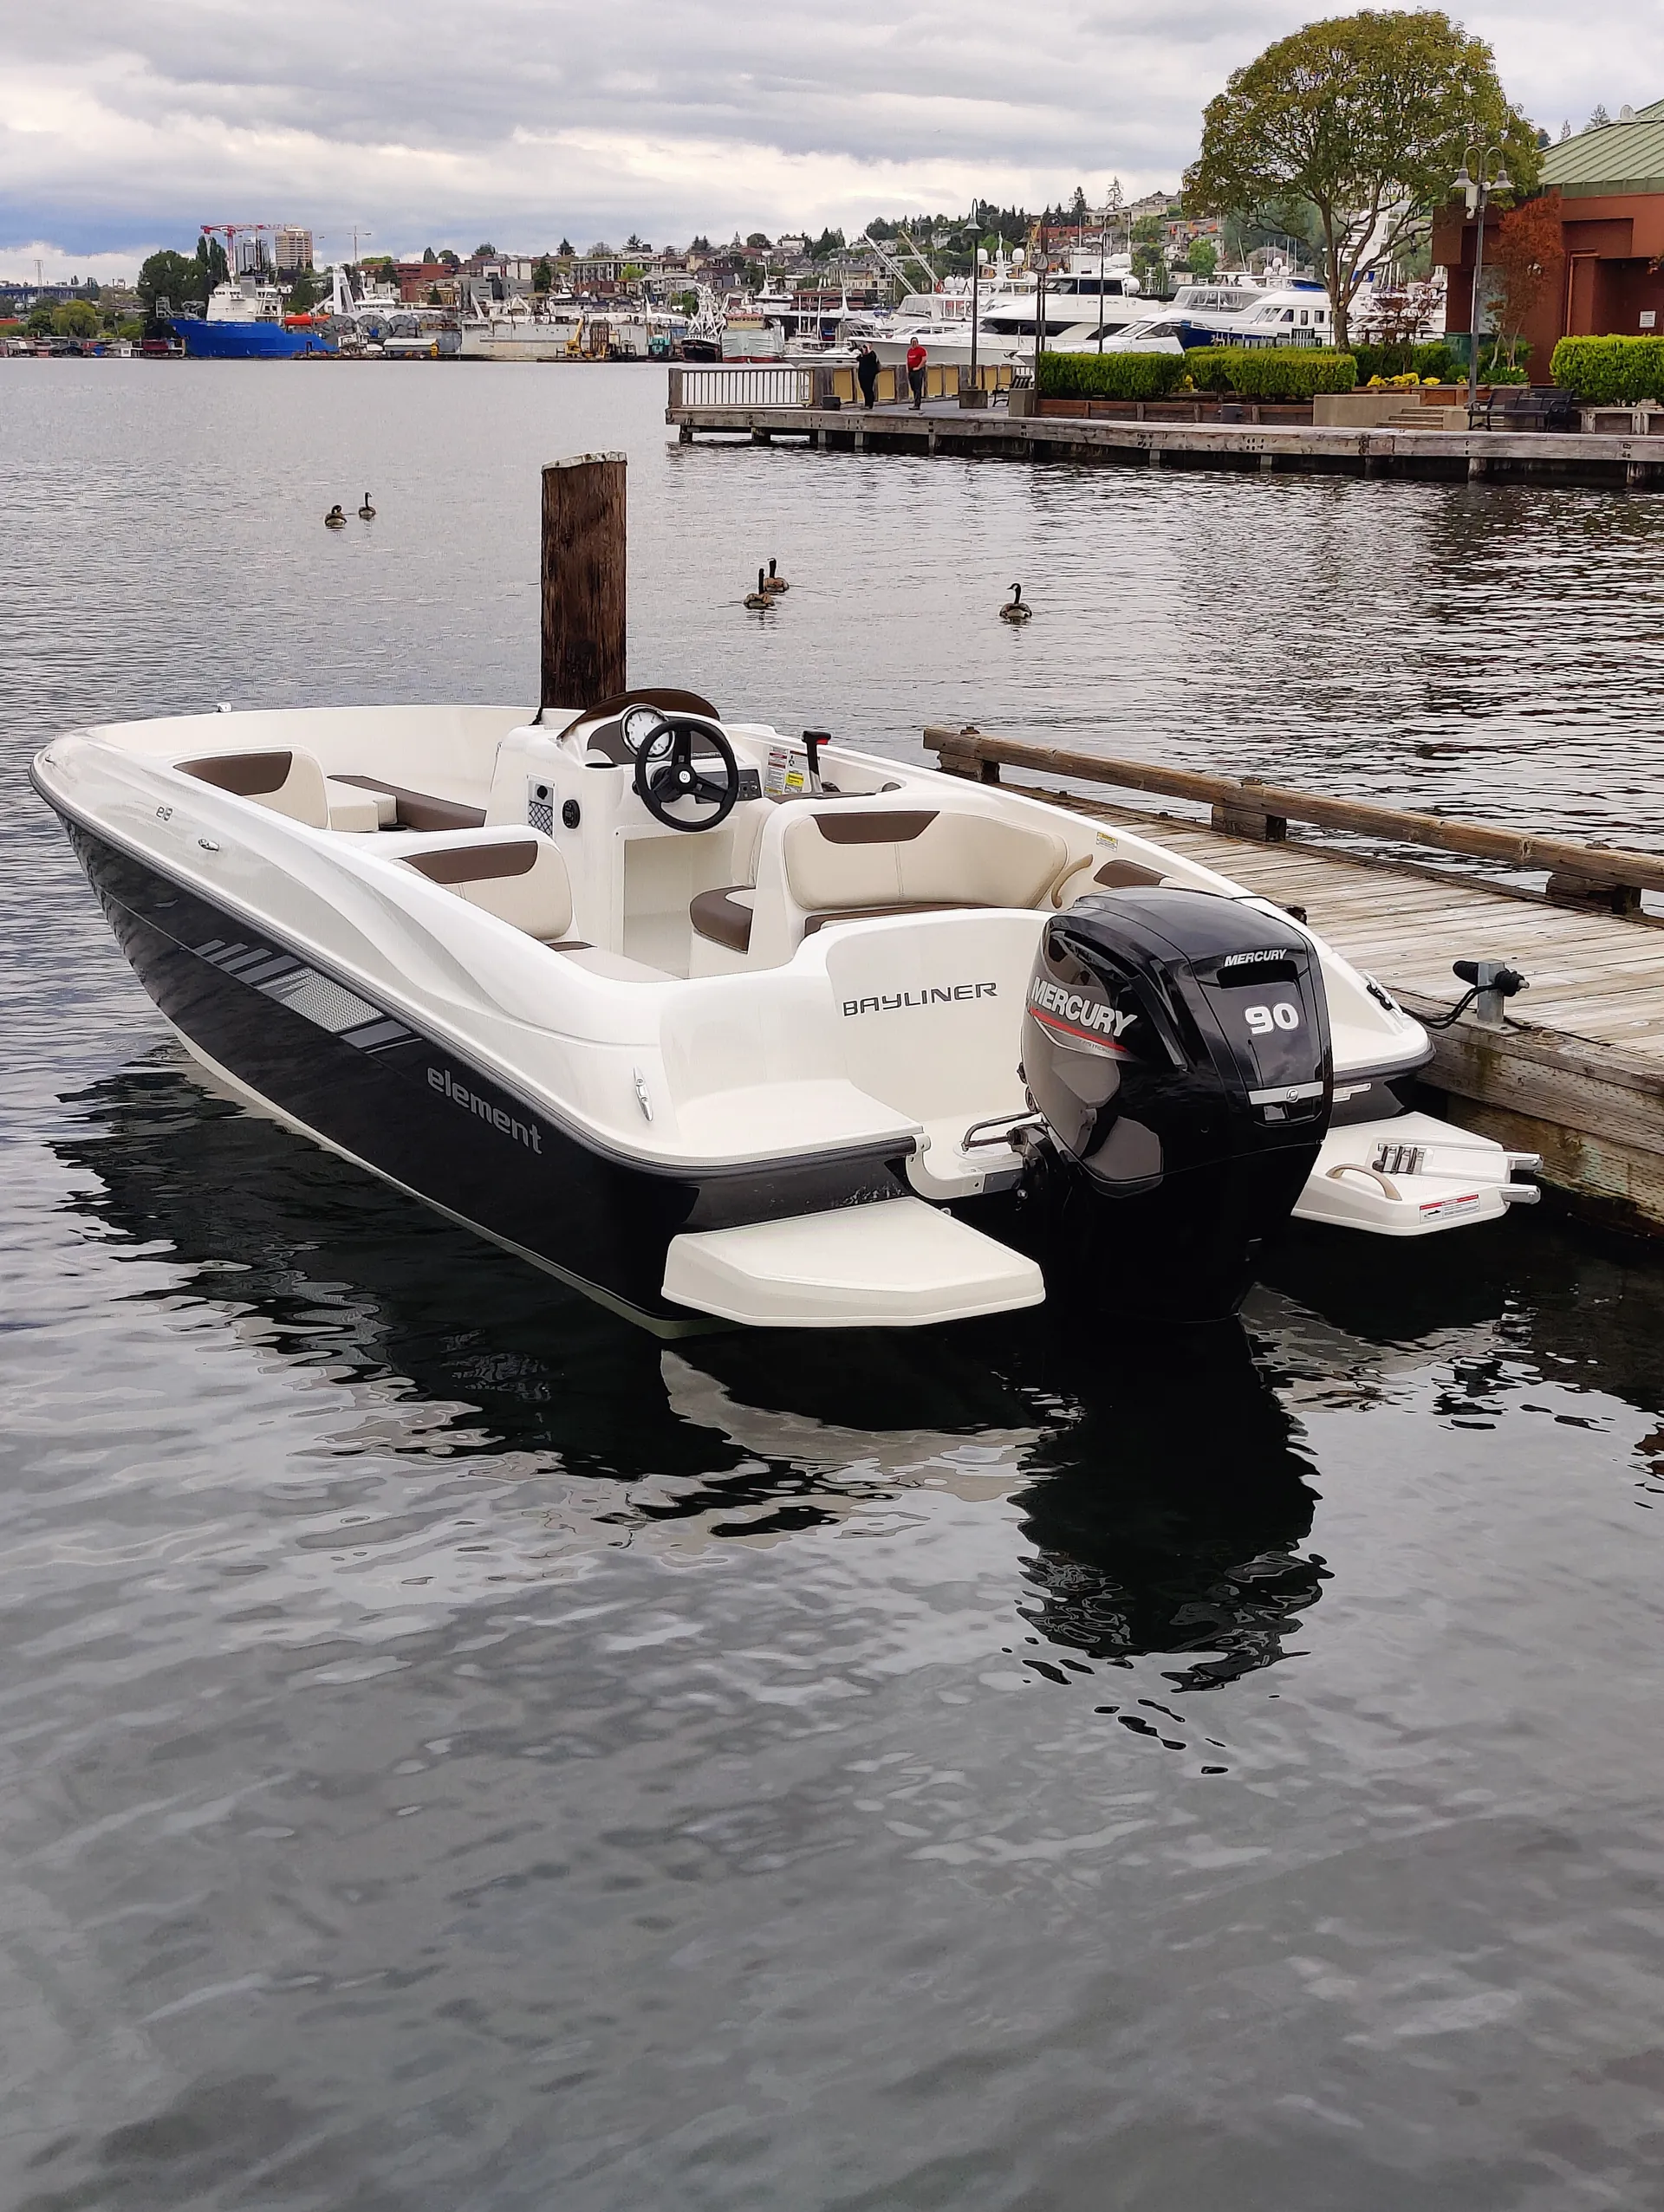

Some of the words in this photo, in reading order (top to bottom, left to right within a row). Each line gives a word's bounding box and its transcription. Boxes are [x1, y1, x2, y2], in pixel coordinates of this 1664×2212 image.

[1224, 949, 1287, 967] MERCURY
[842, 983, 998, 1015] BAYLINER
[1031, 976, 1138, 1037] MERCURY
[1244, 1002, 1300, 1036] 90
[427, 1067, 543, 1155] element
